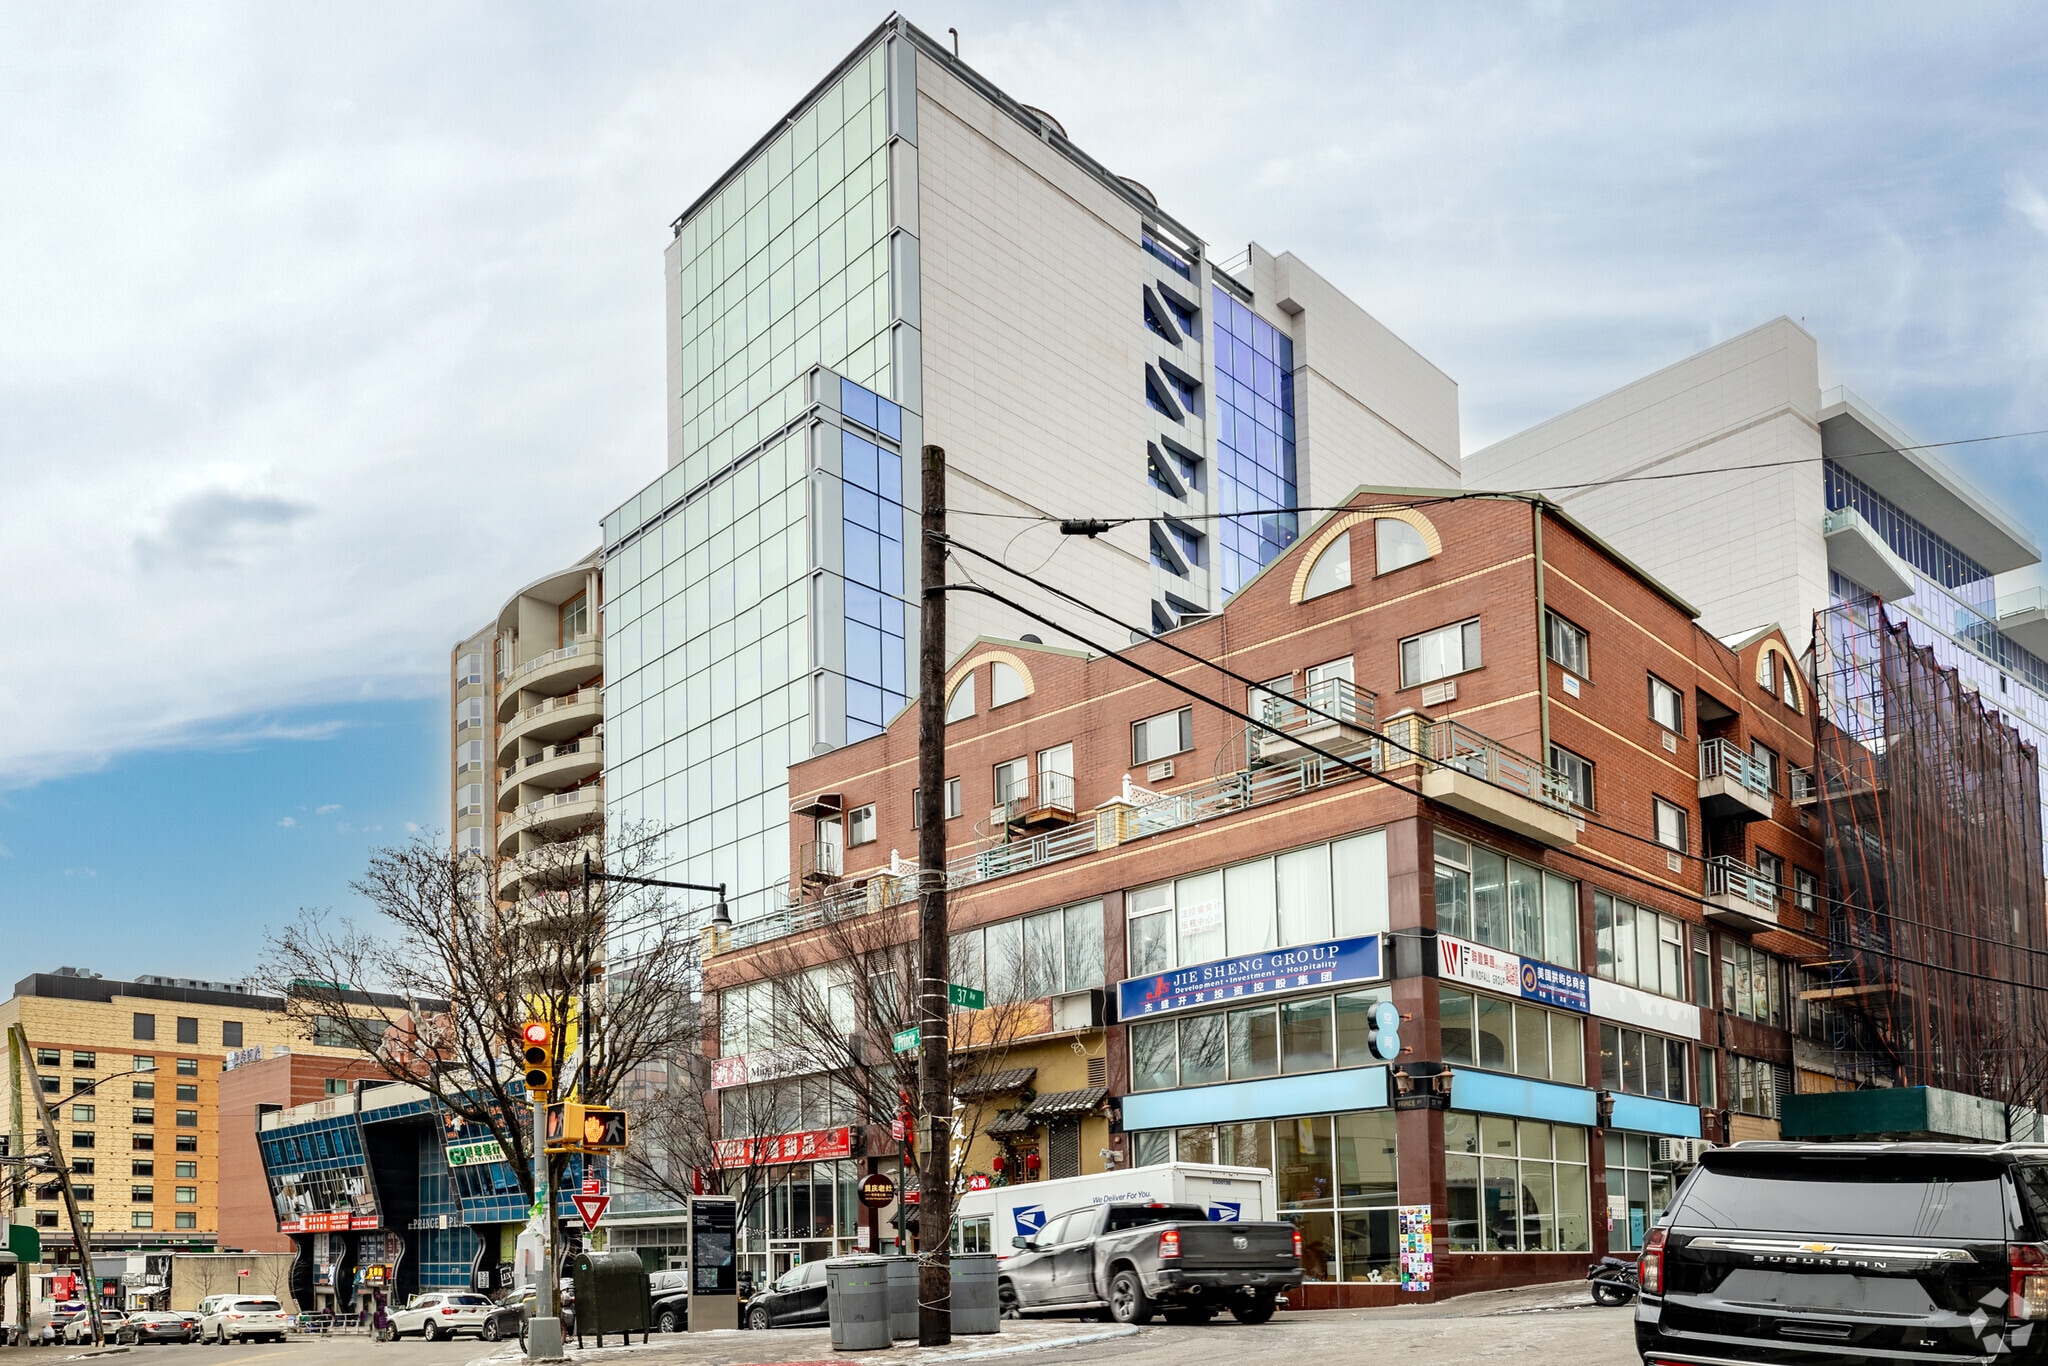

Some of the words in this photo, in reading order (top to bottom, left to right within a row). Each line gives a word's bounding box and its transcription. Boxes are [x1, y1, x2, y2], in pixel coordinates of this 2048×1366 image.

[1173, 970, 1198, 987] JIE
[1204, 957, 1263, 980] SHENG
[1271, 945, 1340, 968] GROUP
[1175, 979, 1224, 994] Development
[1229, 970, 1276, 983] Investment
[1286, 959, 1338, 974] Hospitality
[957, 988, 966, 1004] 37
[897, 1033, 915, 1051] Prince
[1092, 1196, 1102, 1204] We
[1103, 1194, 1126, 1203] Deliver
[1126, 1192, 1136, 1200] For
[1137, 1190, 1151, 1199] You.
[1753, 1255, 1887, 1268] SUBURBAN
